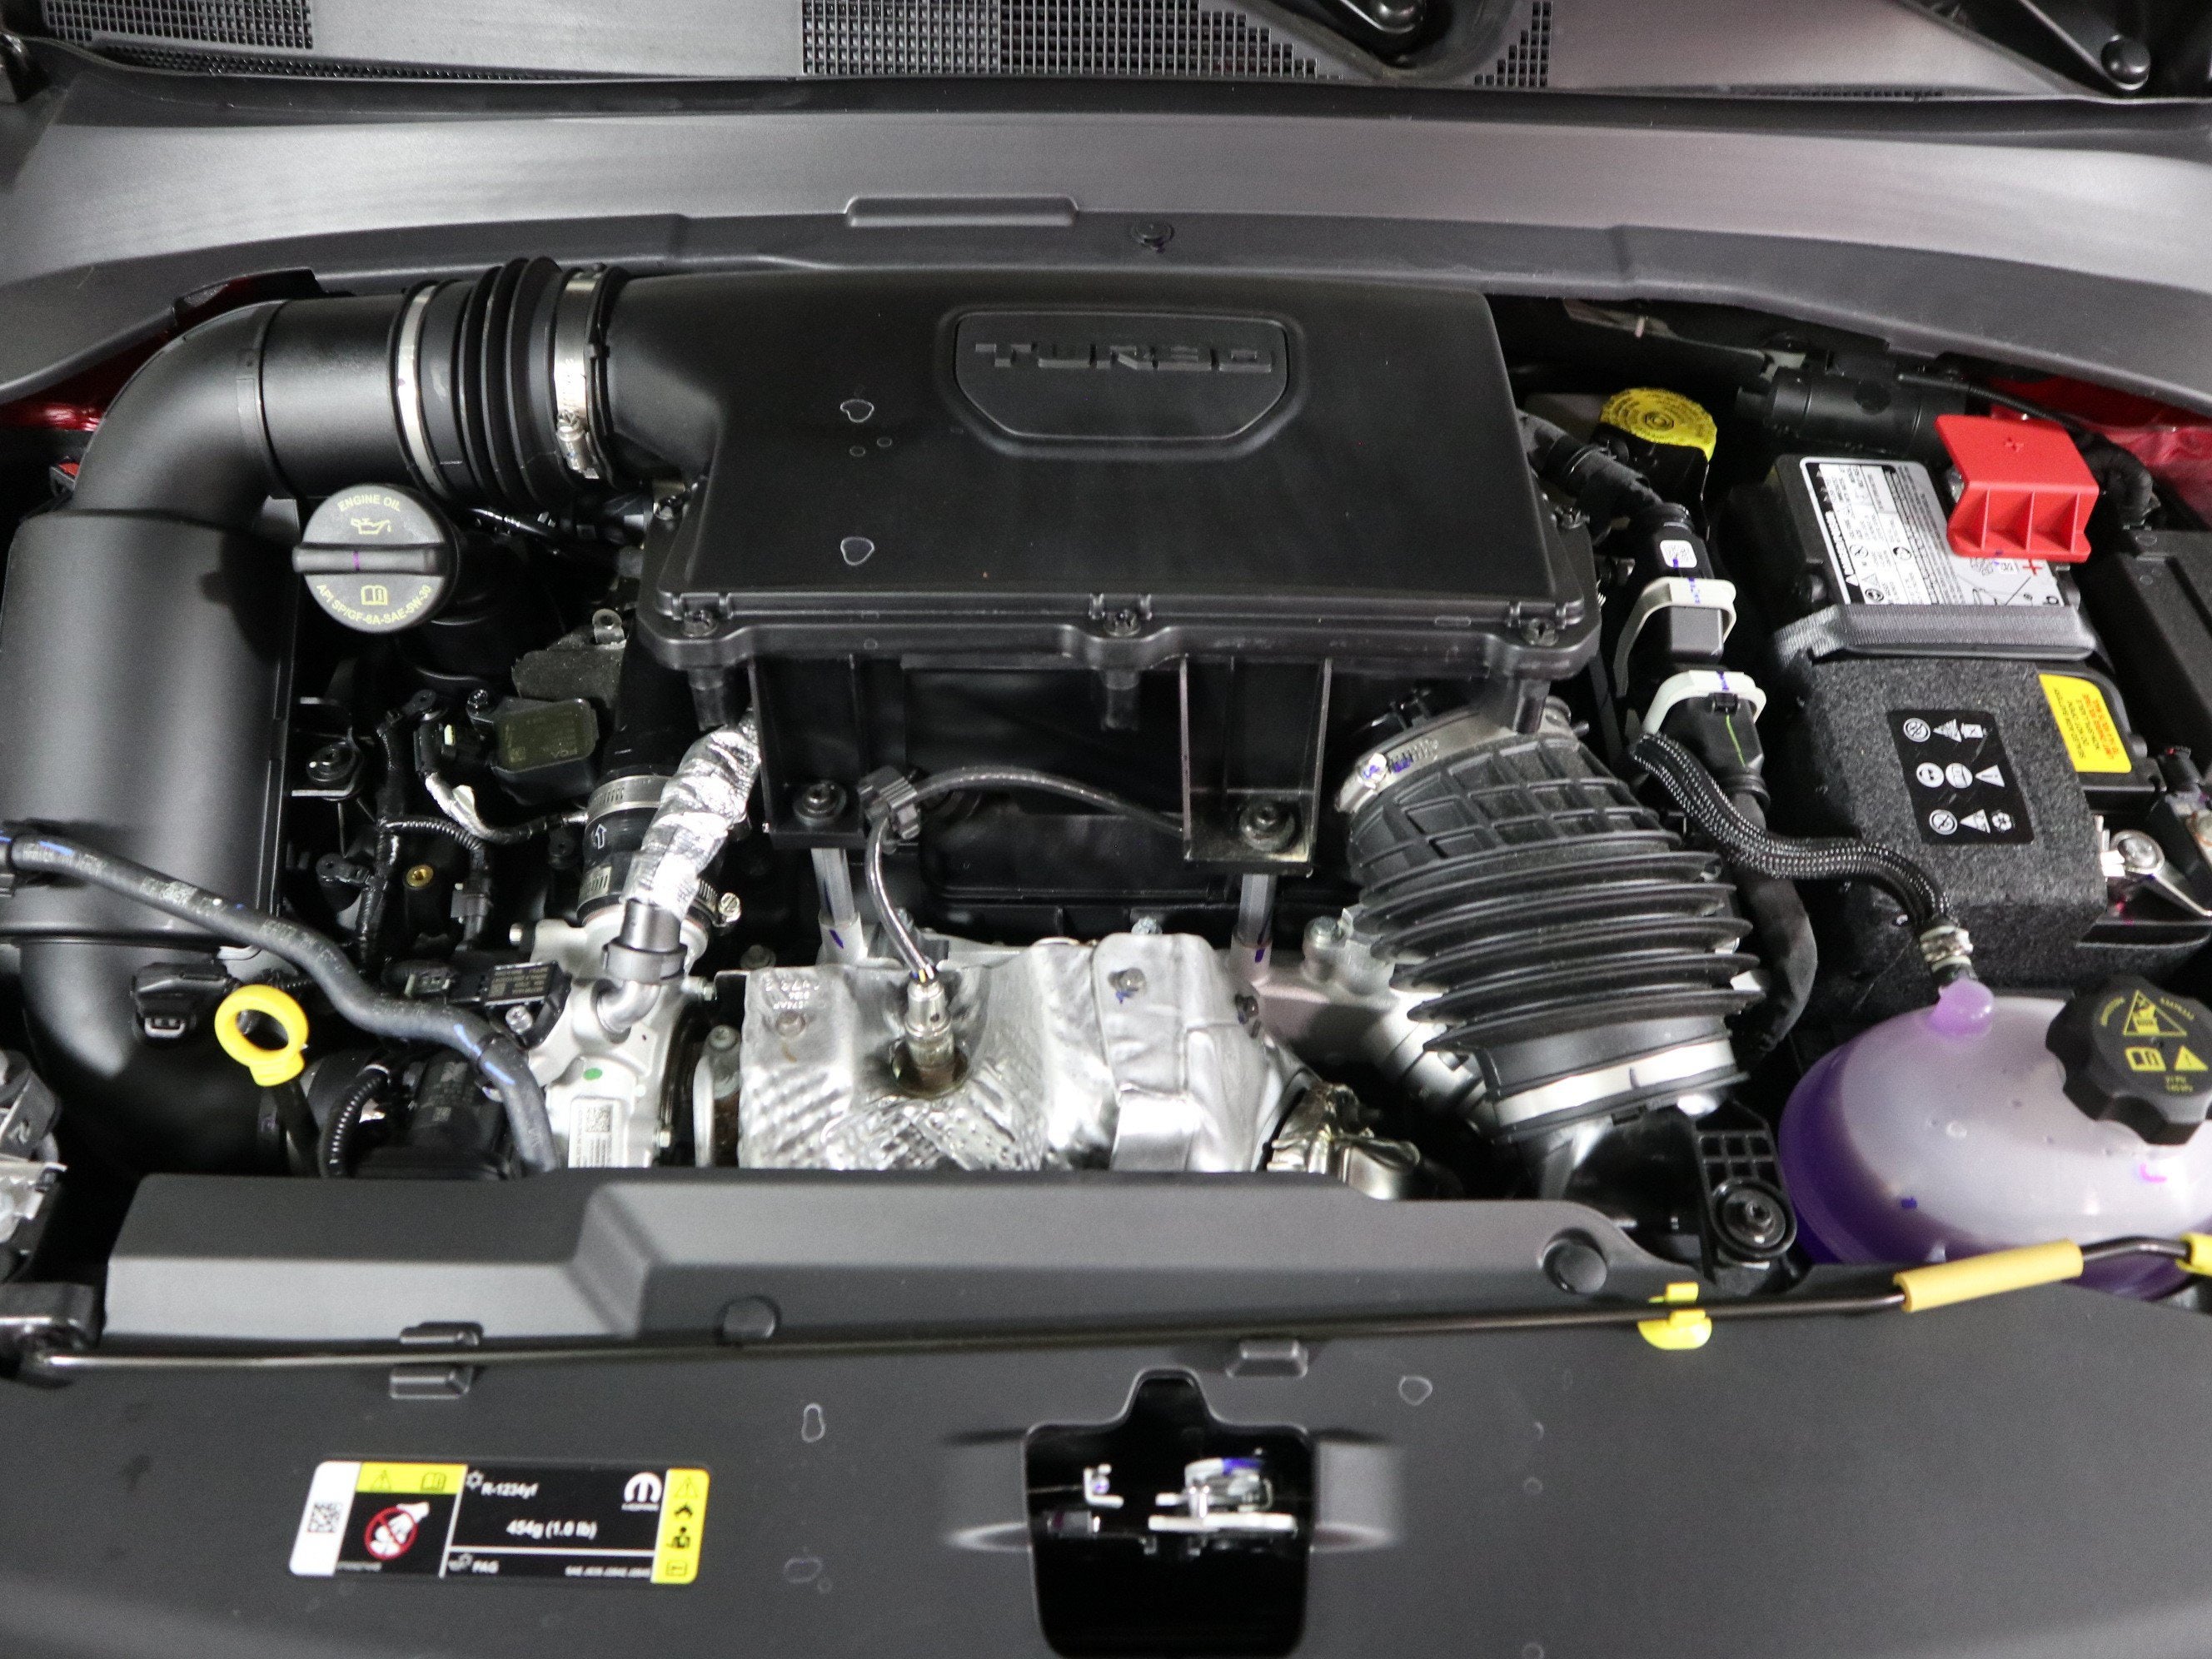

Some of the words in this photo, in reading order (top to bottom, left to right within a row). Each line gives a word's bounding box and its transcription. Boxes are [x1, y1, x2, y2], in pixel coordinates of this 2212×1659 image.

[974, 341, 1273, 373] TURBO
[337, 493, 380, 512] ENGINE
[383, 495, 401, 512] OIL
[316, 584, 335, 603] API
[481, 1481, 540, 1500] R-1234yf
[506, 1518, 546, 1540] 454g
[545, 1520, 575, 1540] (1.0
[575, 1520, 598, 1541] lb)
